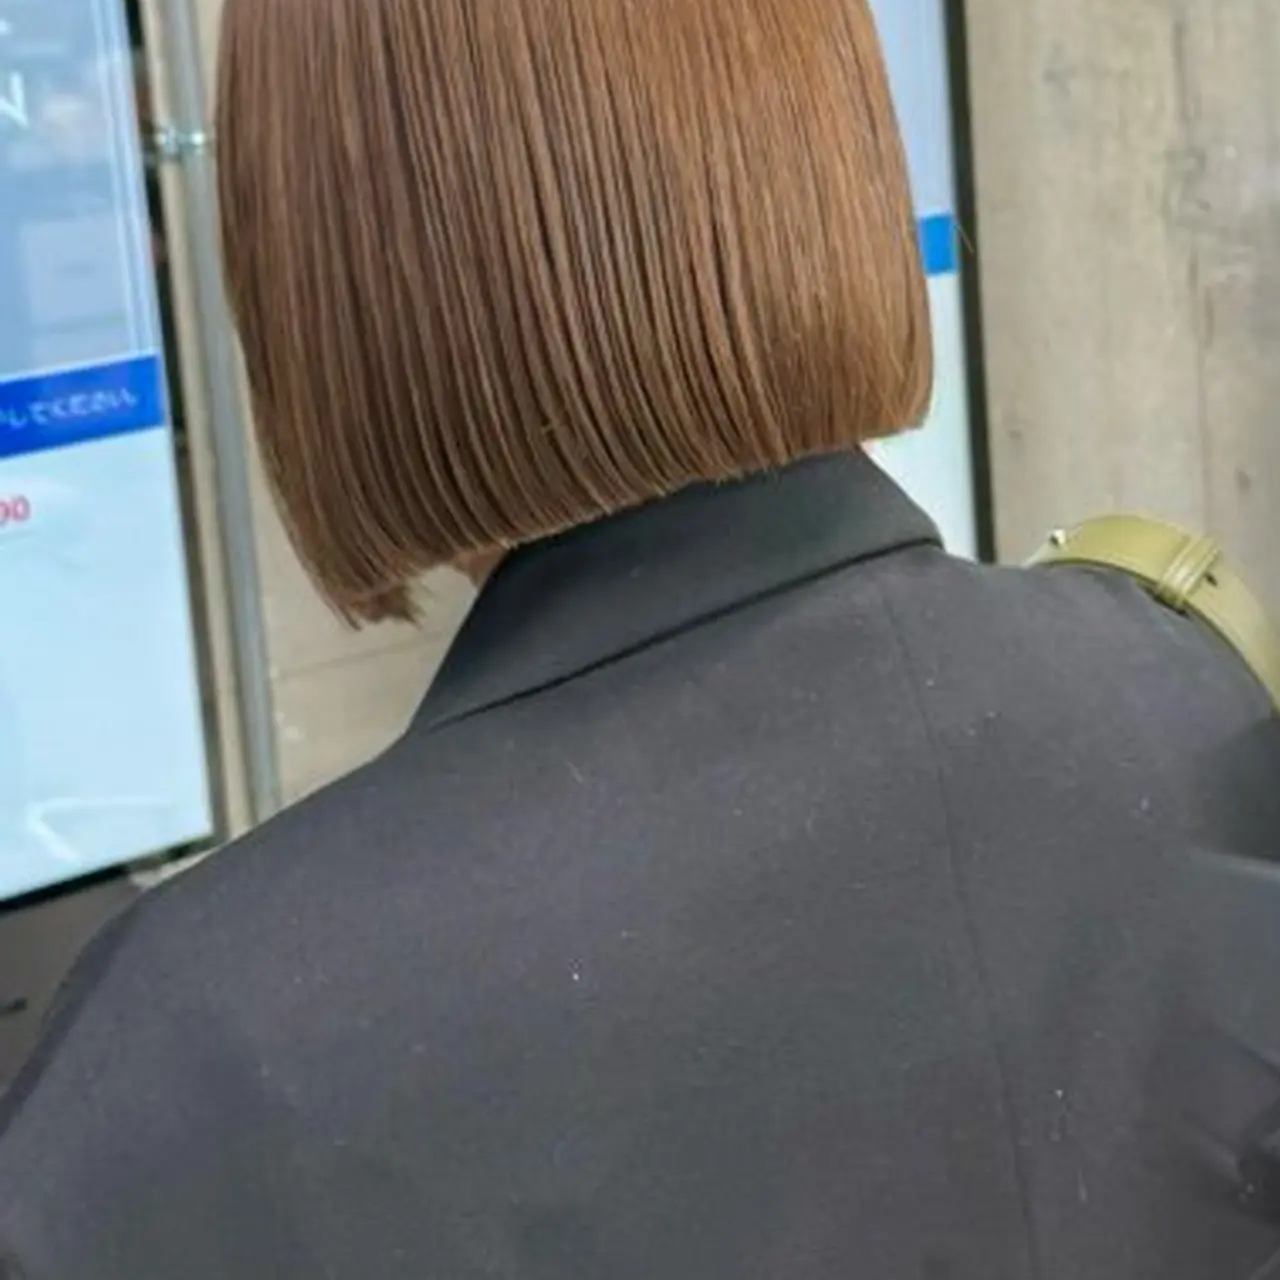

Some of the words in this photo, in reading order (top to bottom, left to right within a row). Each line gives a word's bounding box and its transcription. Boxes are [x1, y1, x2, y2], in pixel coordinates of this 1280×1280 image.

[0, 386, 139, 430] してください
